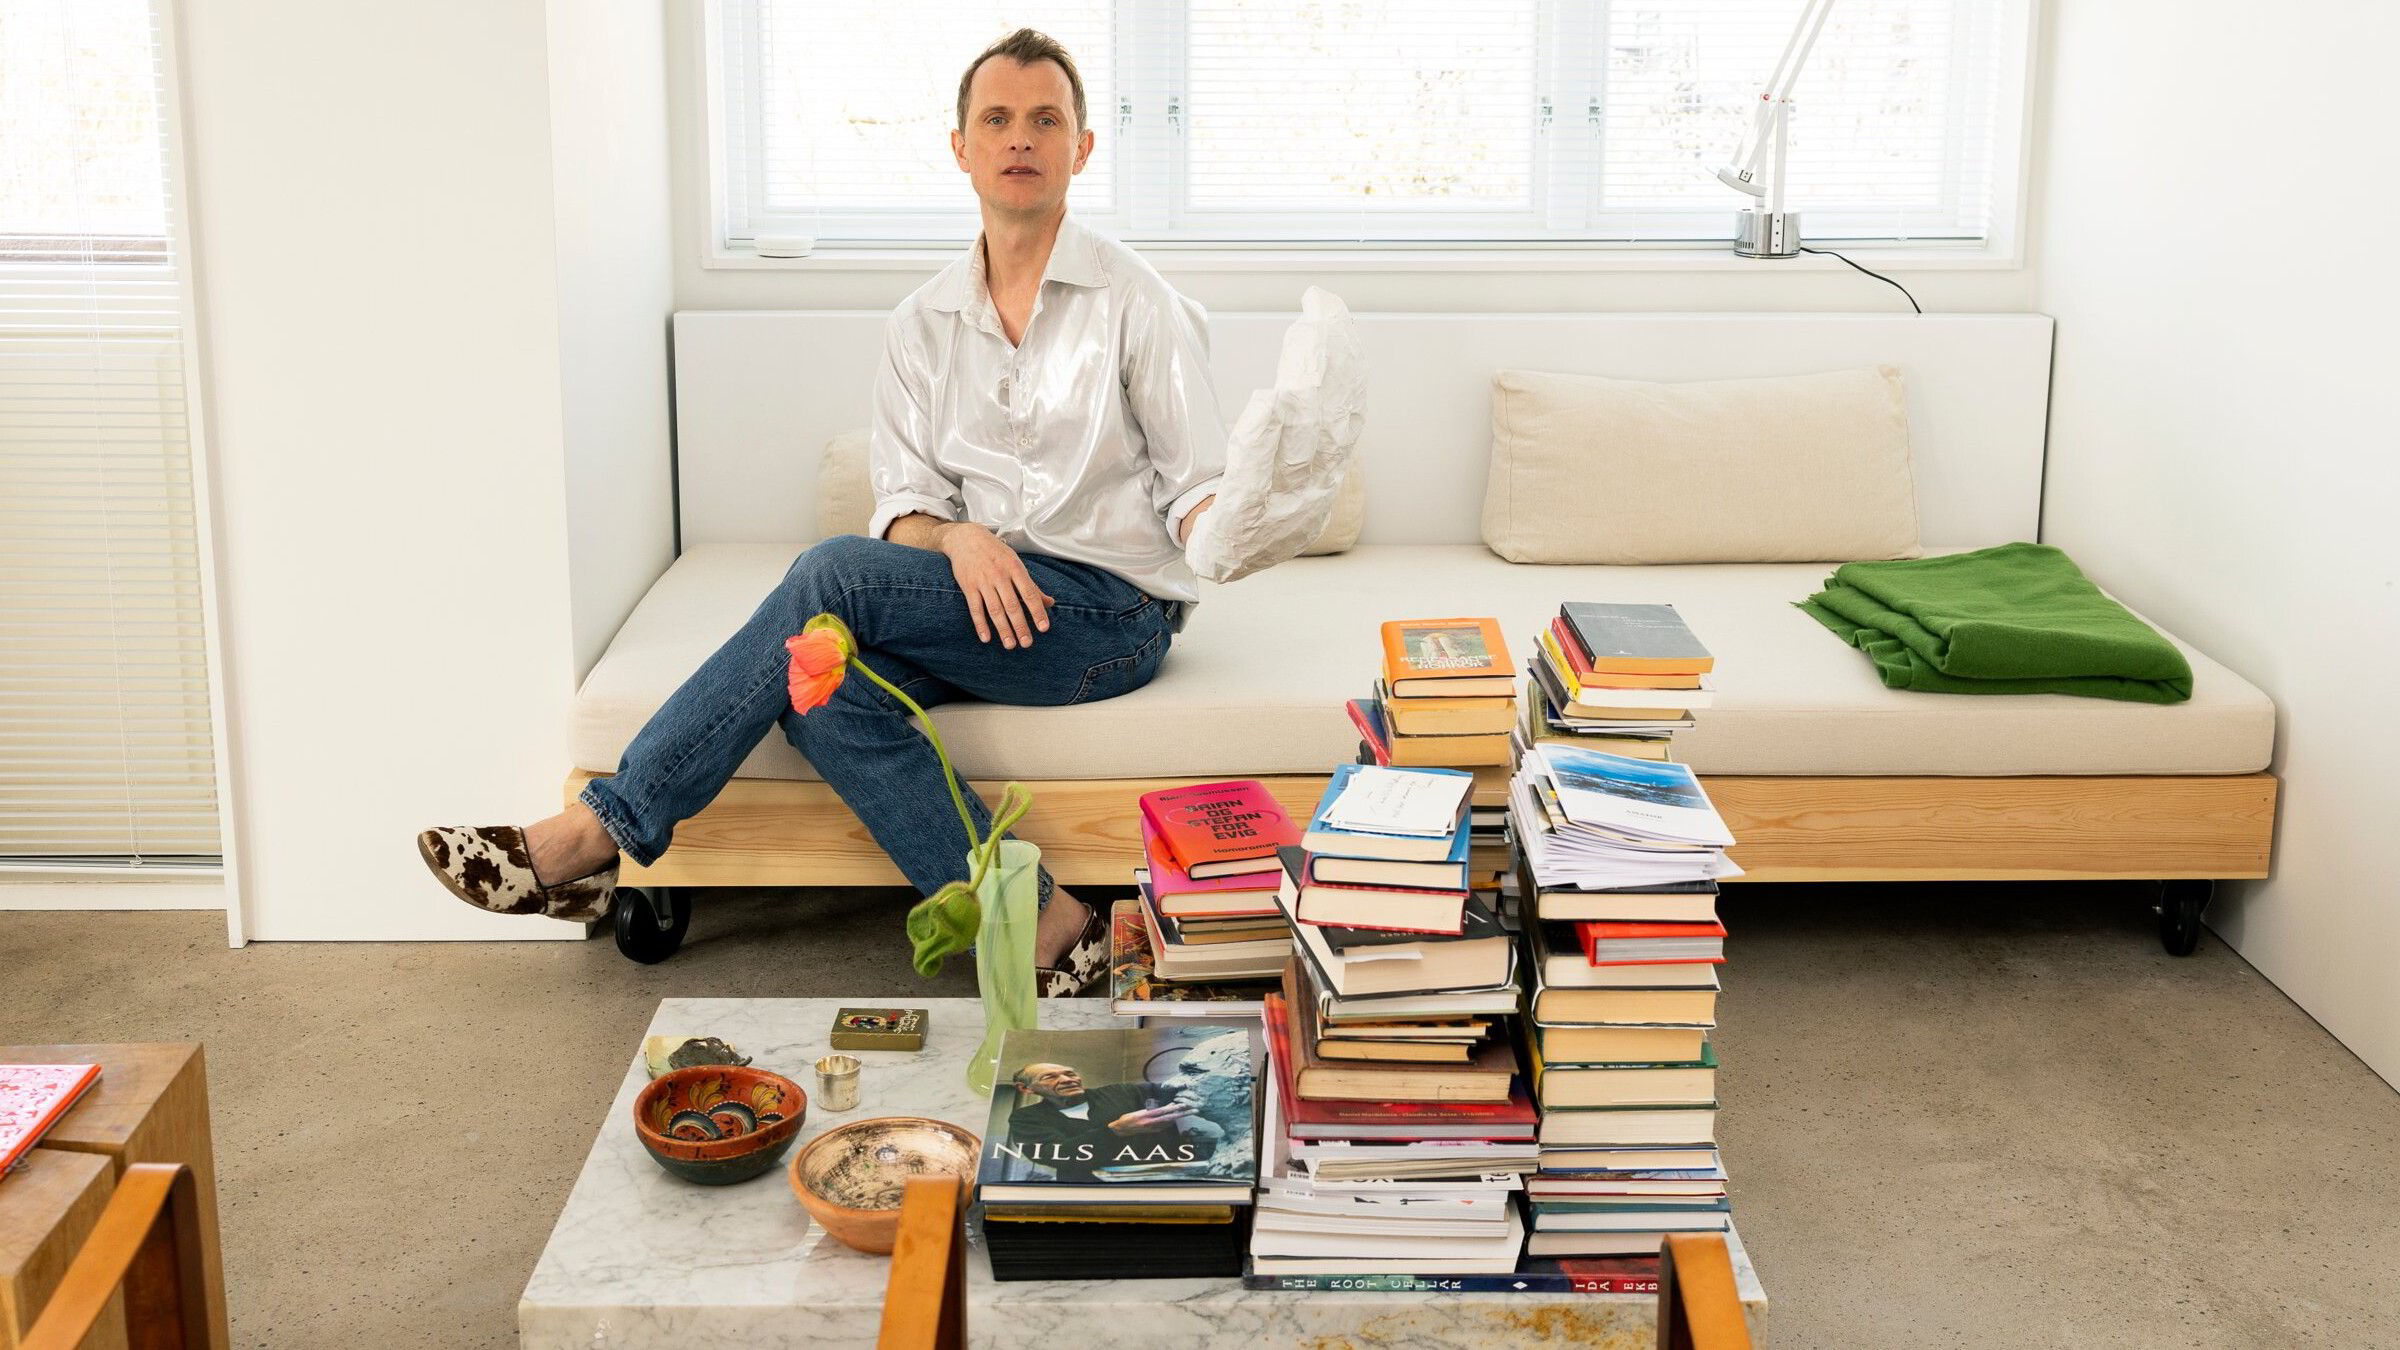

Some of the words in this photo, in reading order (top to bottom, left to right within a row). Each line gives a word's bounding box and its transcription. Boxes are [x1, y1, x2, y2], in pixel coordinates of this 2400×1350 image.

[1184, 800, 1244, 813] BRIAN
[1208, 809, 1233, 817] OG
[1187, 812, 1262, 827] STEFAN
[1211, 822, 1249, 832] FOR
[1213, 829, 1258, 840] EVIG
[991, 1142, 1095, 1161] NILS
[1112, 1144, 1196, 1161] AAS
[1282, 1279, 1317, 1288] THE
[1330, 1279, 1377, 1289] ROOT
[1390, 1279, 1462, 1289] CELLAR
[1575, 1281, 1610, 1291] IDA
[1623, 1282, 1658, 1291] EKB
